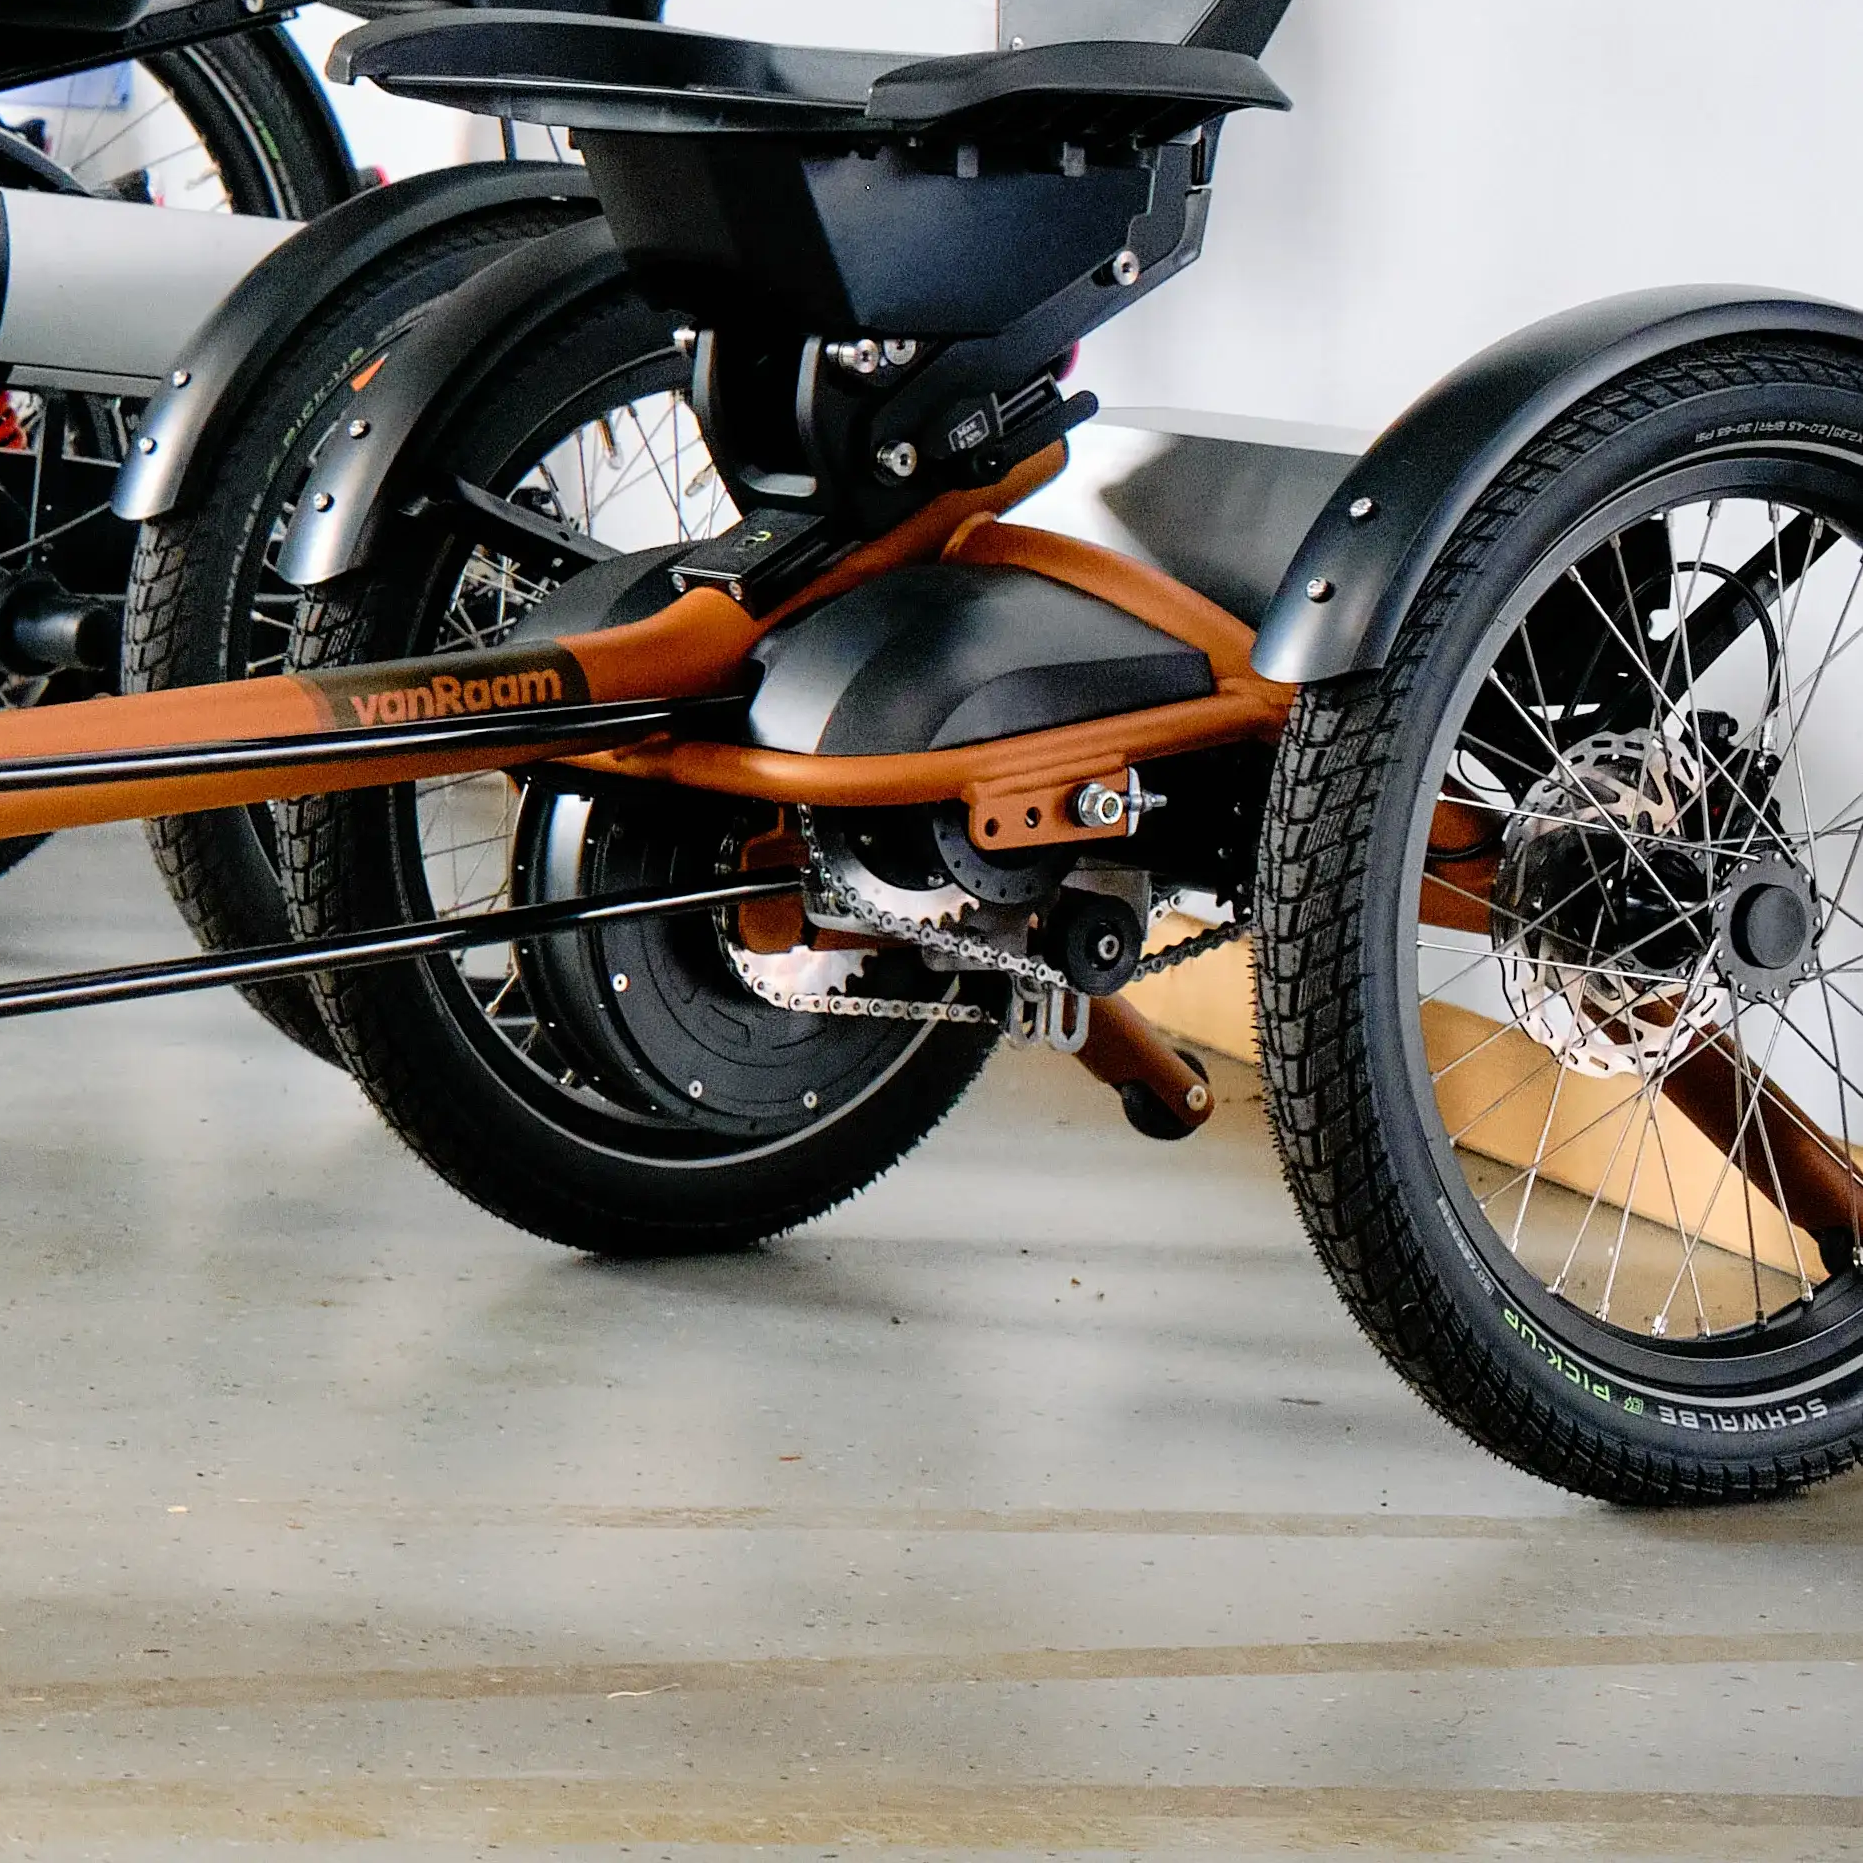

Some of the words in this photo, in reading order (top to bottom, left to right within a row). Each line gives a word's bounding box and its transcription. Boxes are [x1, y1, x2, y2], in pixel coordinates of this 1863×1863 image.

[349, 666, 564, 728] vanRaam
[1502, 1307, 1613, 1404] PICK-UP
[1658, 1396, 1830, 1435] SCHWALBE
